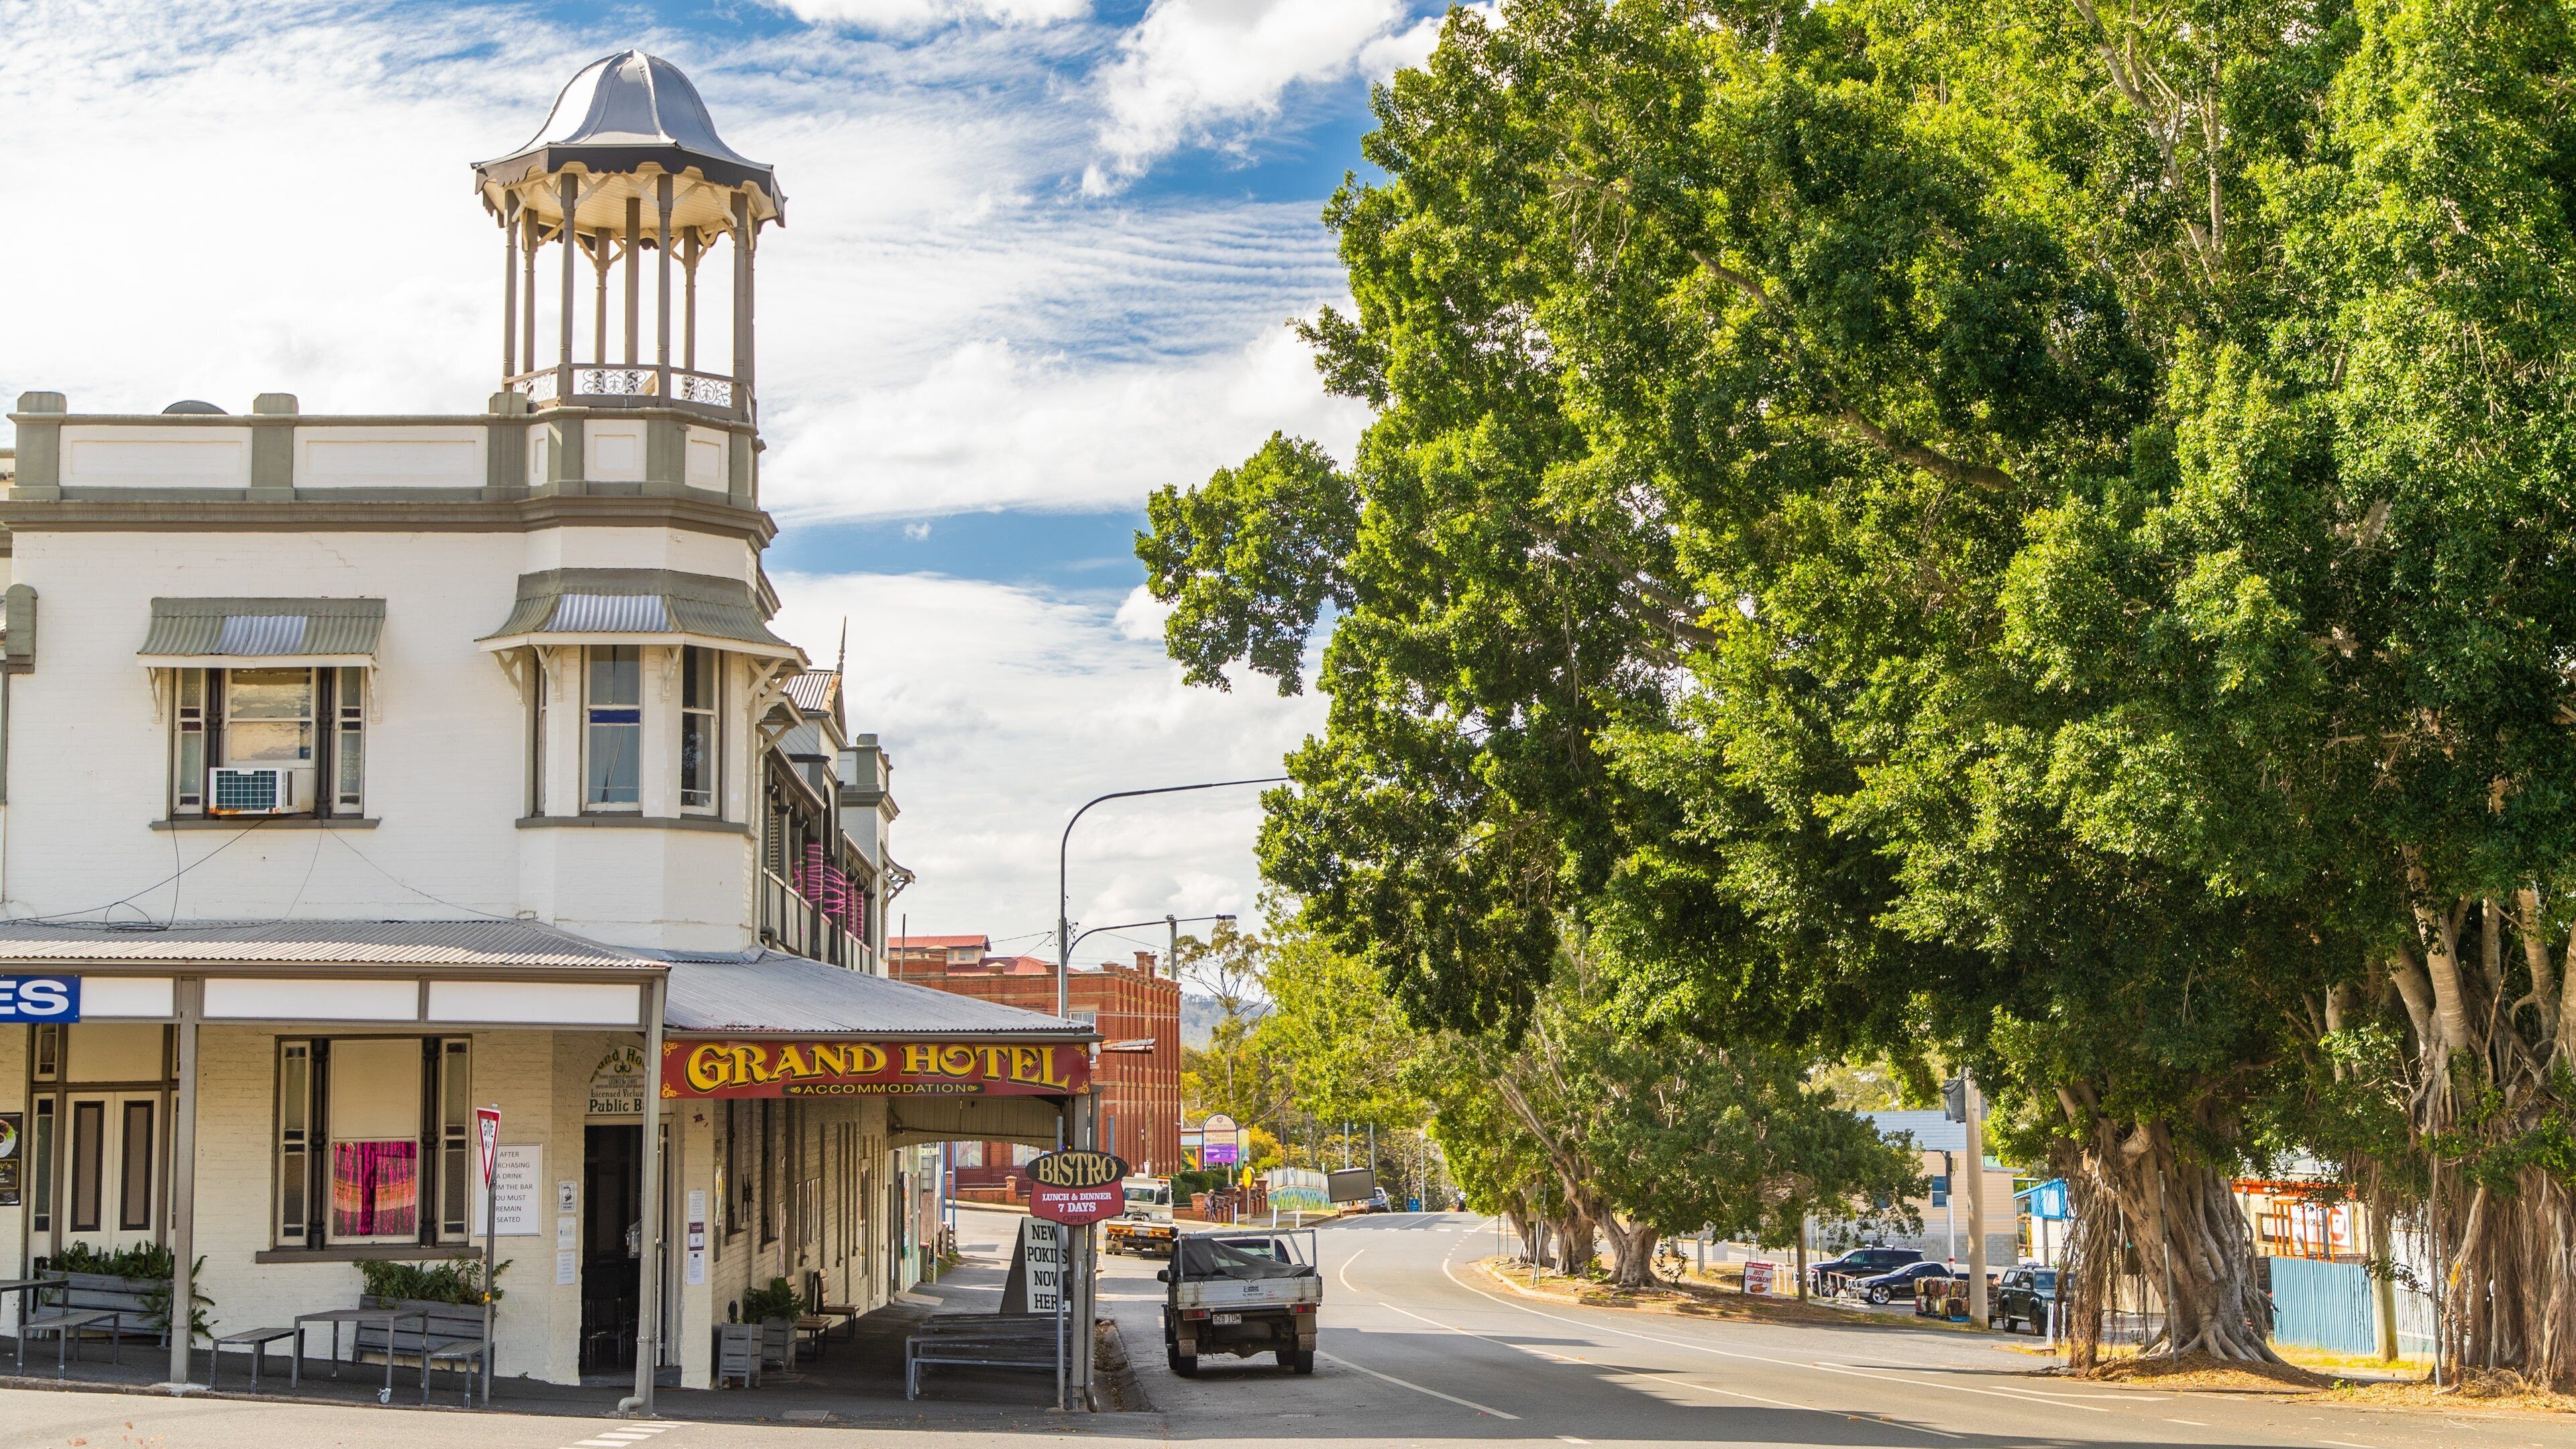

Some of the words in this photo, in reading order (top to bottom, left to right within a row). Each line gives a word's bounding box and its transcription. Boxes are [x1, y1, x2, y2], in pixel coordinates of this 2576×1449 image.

[598, 1049, 619, 1070] and
[684, 1043, 888, 1094] GRAND
[900, 1044, 1071, 1093] HOTEL
[591, 1089, 621, 1097] Licensed
[623, 1089, 643, 1097] Victua
[804, 1084, 966, 1095] ACCOMMODATION
[589, 1099, 629, 1112] Public
[634, 1099, 645, 1112] B
[484, 1124, 494, 1138] GIVE
[0, 1162, 11, 1172] y's
[1038, 1152, 1118, 1187] BISTRO
[1042, 1193, 1069, 1201] LUNCH
[1071, 1193, 1078, 1201] &
[1080, 1192, 1112, 1201] DINNER
[1058, 1203, 1065, 1213] 7
[1067, 1202, 1096, 1213] DAYS
[1063, 1215, 1091, 1223] OPEN
[1032, 1225, 1057, 1241] NEW
[1027, 1246, 1068, 1265] POKIS
[1034, 1293, 1066, 1311] HER
